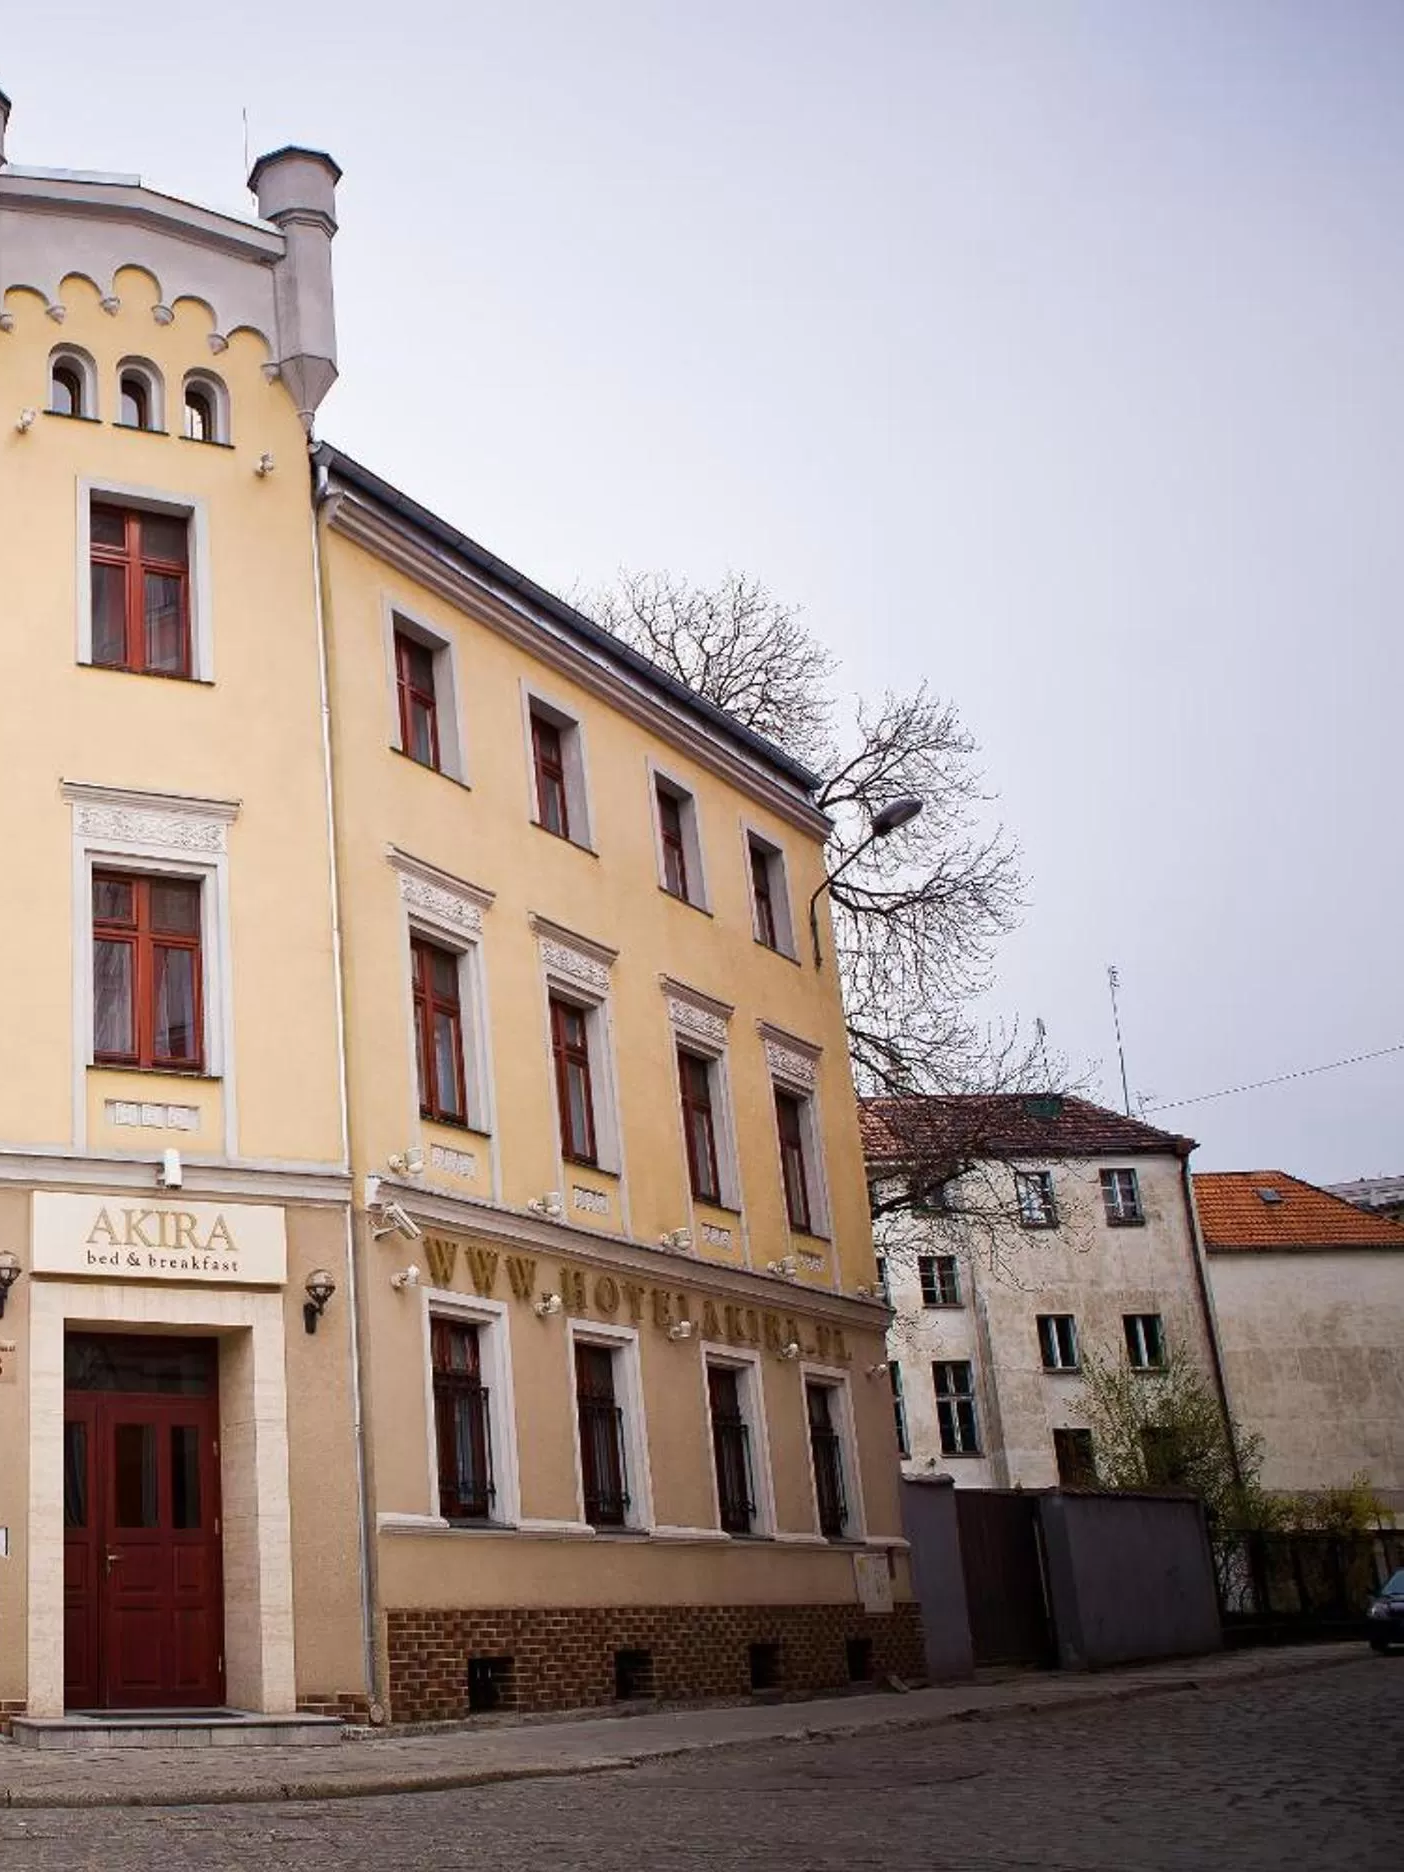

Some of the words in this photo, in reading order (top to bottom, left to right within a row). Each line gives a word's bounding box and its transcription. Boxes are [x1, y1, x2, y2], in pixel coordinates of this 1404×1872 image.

[86, 1204, 239, 1252] AKIRA
[87, 1249, 119, 1265] bed
[126, 1251, 141, 1267] &
[148, 1253, 239, 1273] breakfast
